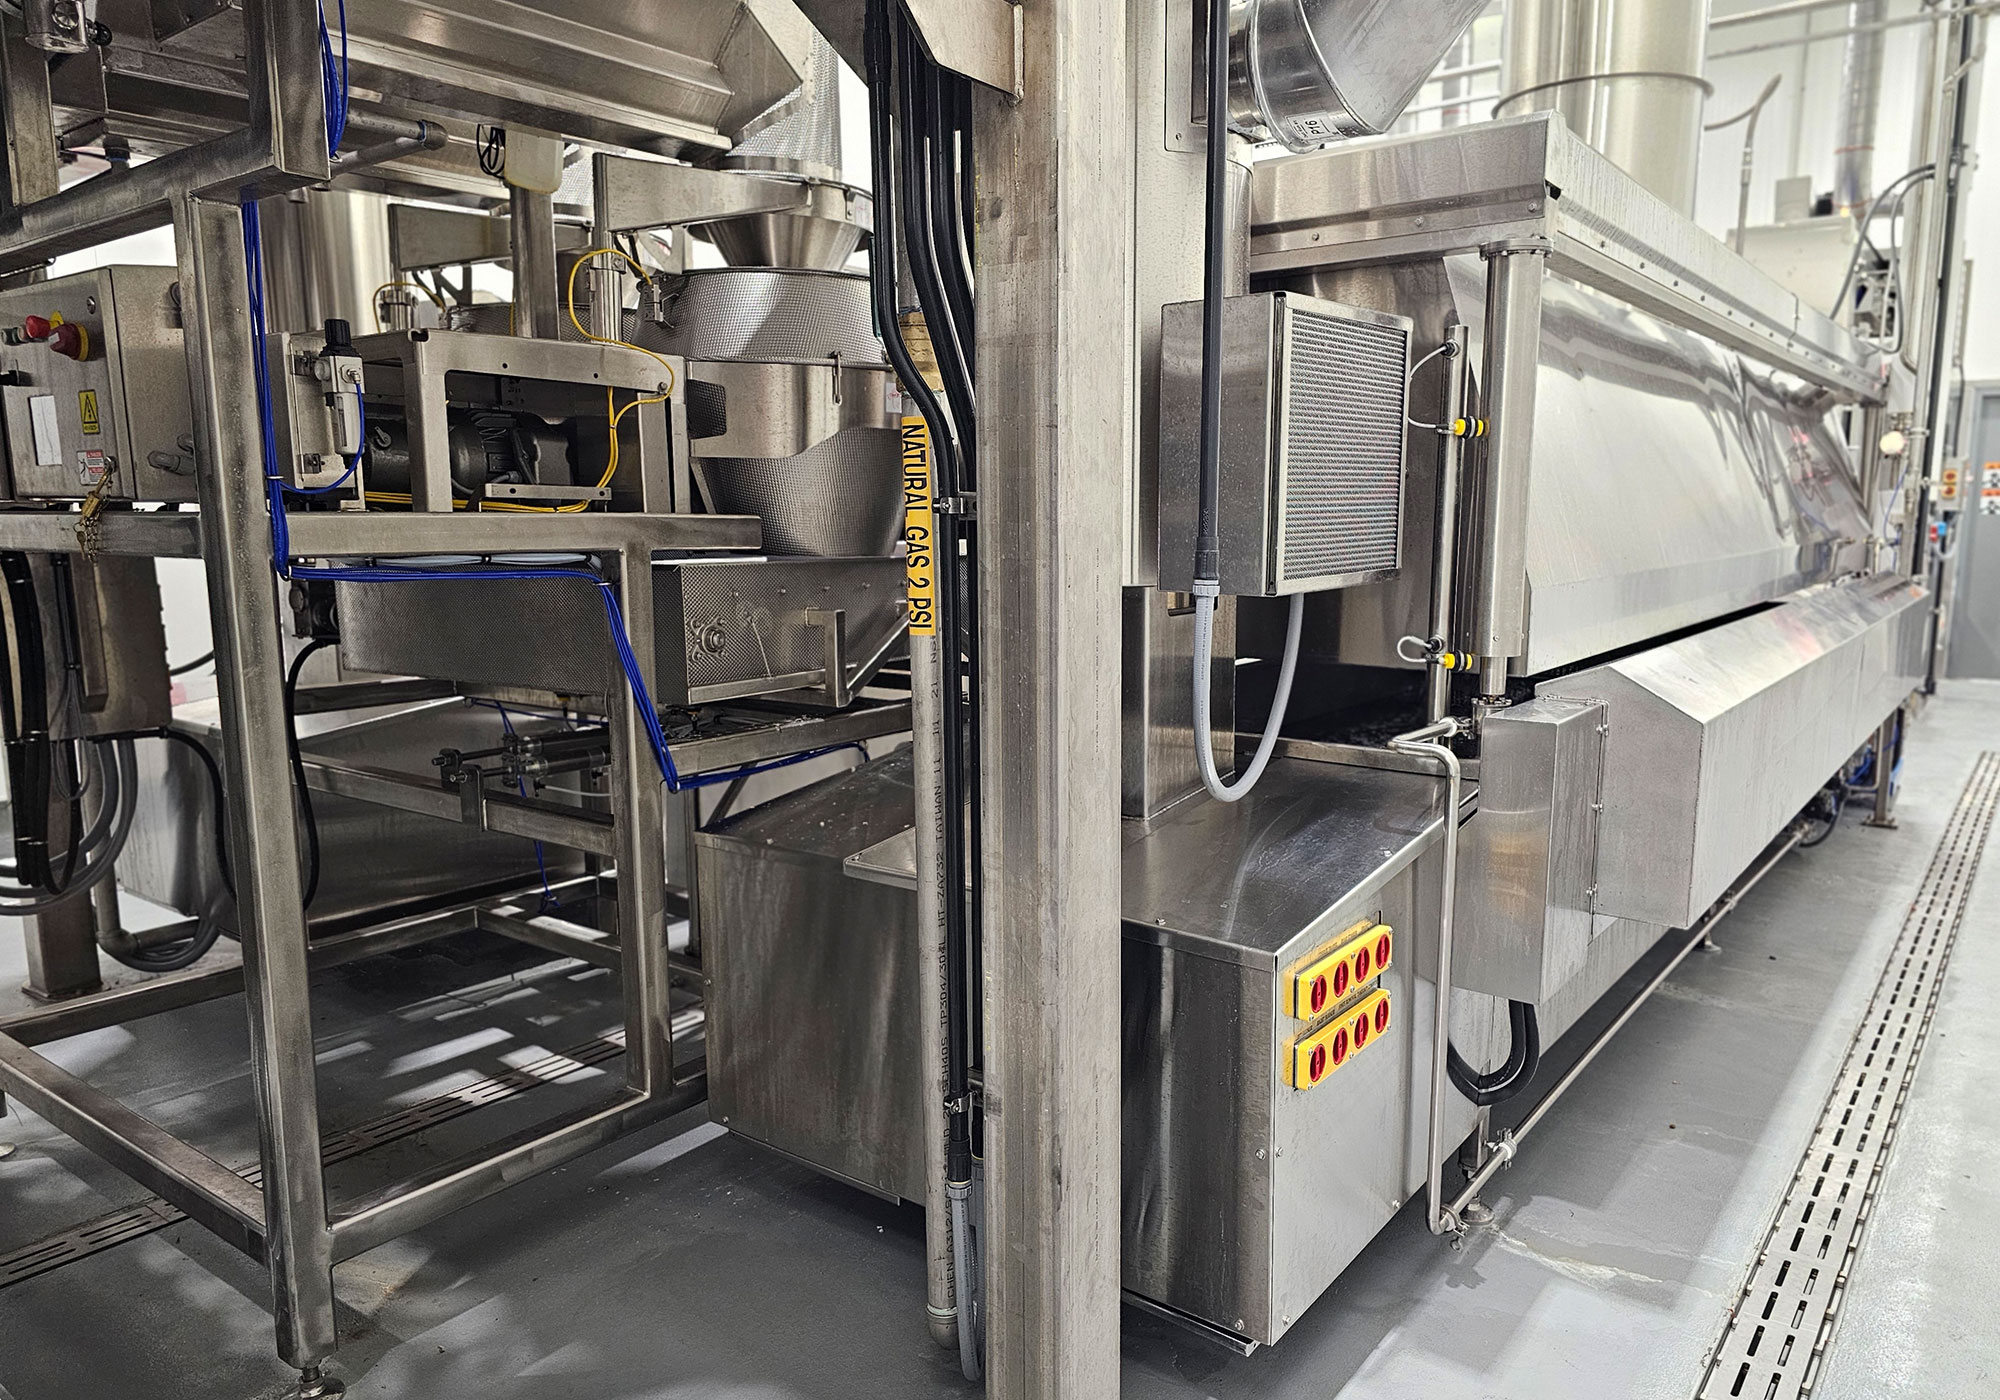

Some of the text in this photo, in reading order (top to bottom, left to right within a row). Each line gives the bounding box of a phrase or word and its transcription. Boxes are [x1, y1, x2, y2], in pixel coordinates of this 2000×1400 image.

[902, 424, 932, 628] NATURAL GAS 2 PSI
[934, 785, 943, 843] TAIWAN
[936, 852, 946, 928] HT-ZA732
[940, 1037, 950, 1093] SCH40S
[946, 1262, 955, 1298] CHEN
